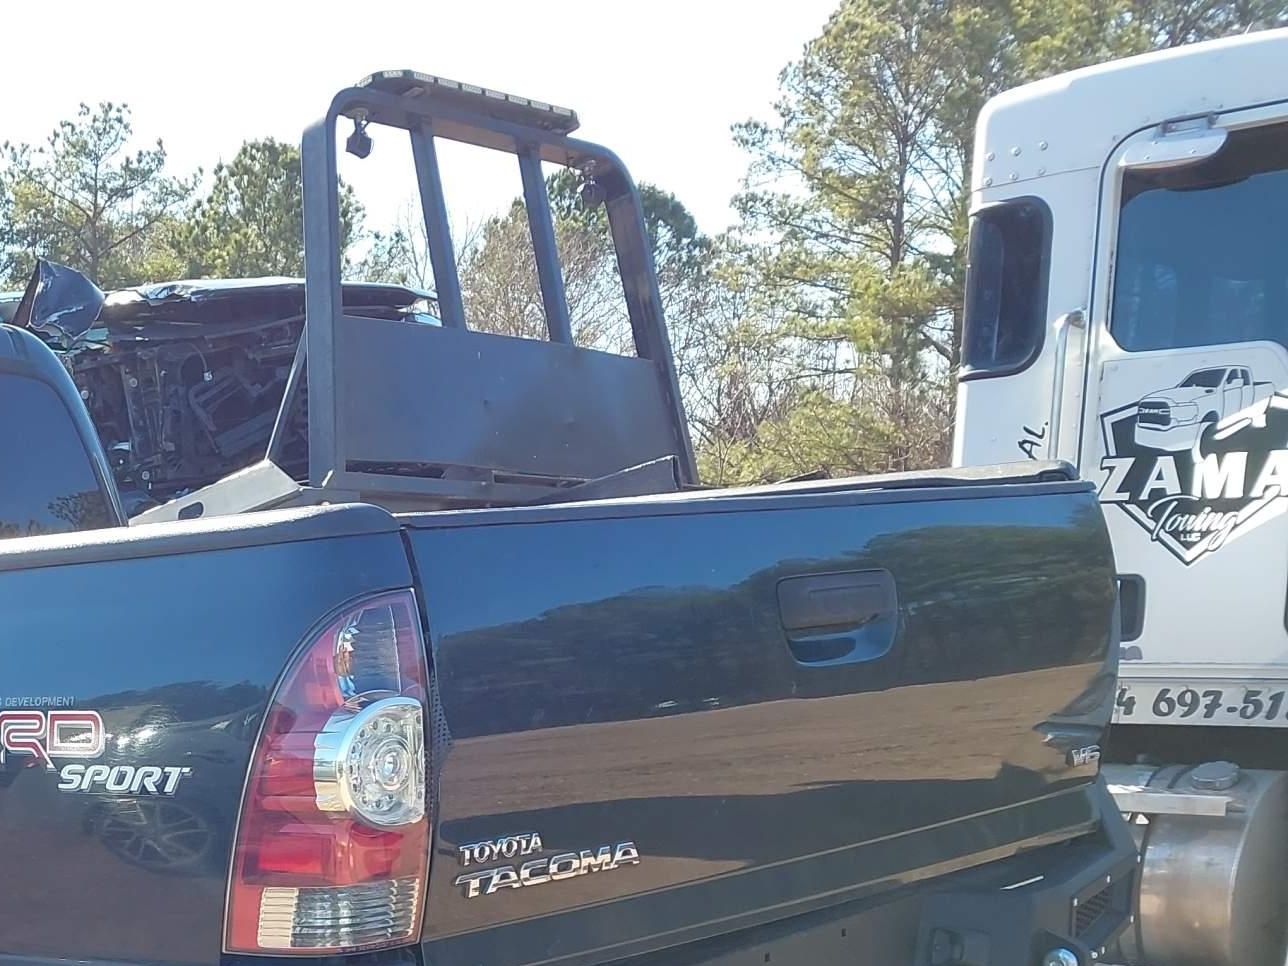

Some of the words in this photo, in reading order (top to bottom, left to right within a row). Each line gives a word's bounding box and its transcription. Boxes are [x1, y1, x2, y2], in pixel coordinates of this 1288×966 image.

[1099, 449, 1288, 501] ZAMA
[1147, 494, 1238, 551] Towing
[5, 695, 75, 707] DEVELOPMENT
[1152, 687, 1288, 720] 697-51
[58, 763, 195, 797] SPORT
[459, 832, 543, 867] TOYOTA
[455, 841, 641, 899] TACOMA
